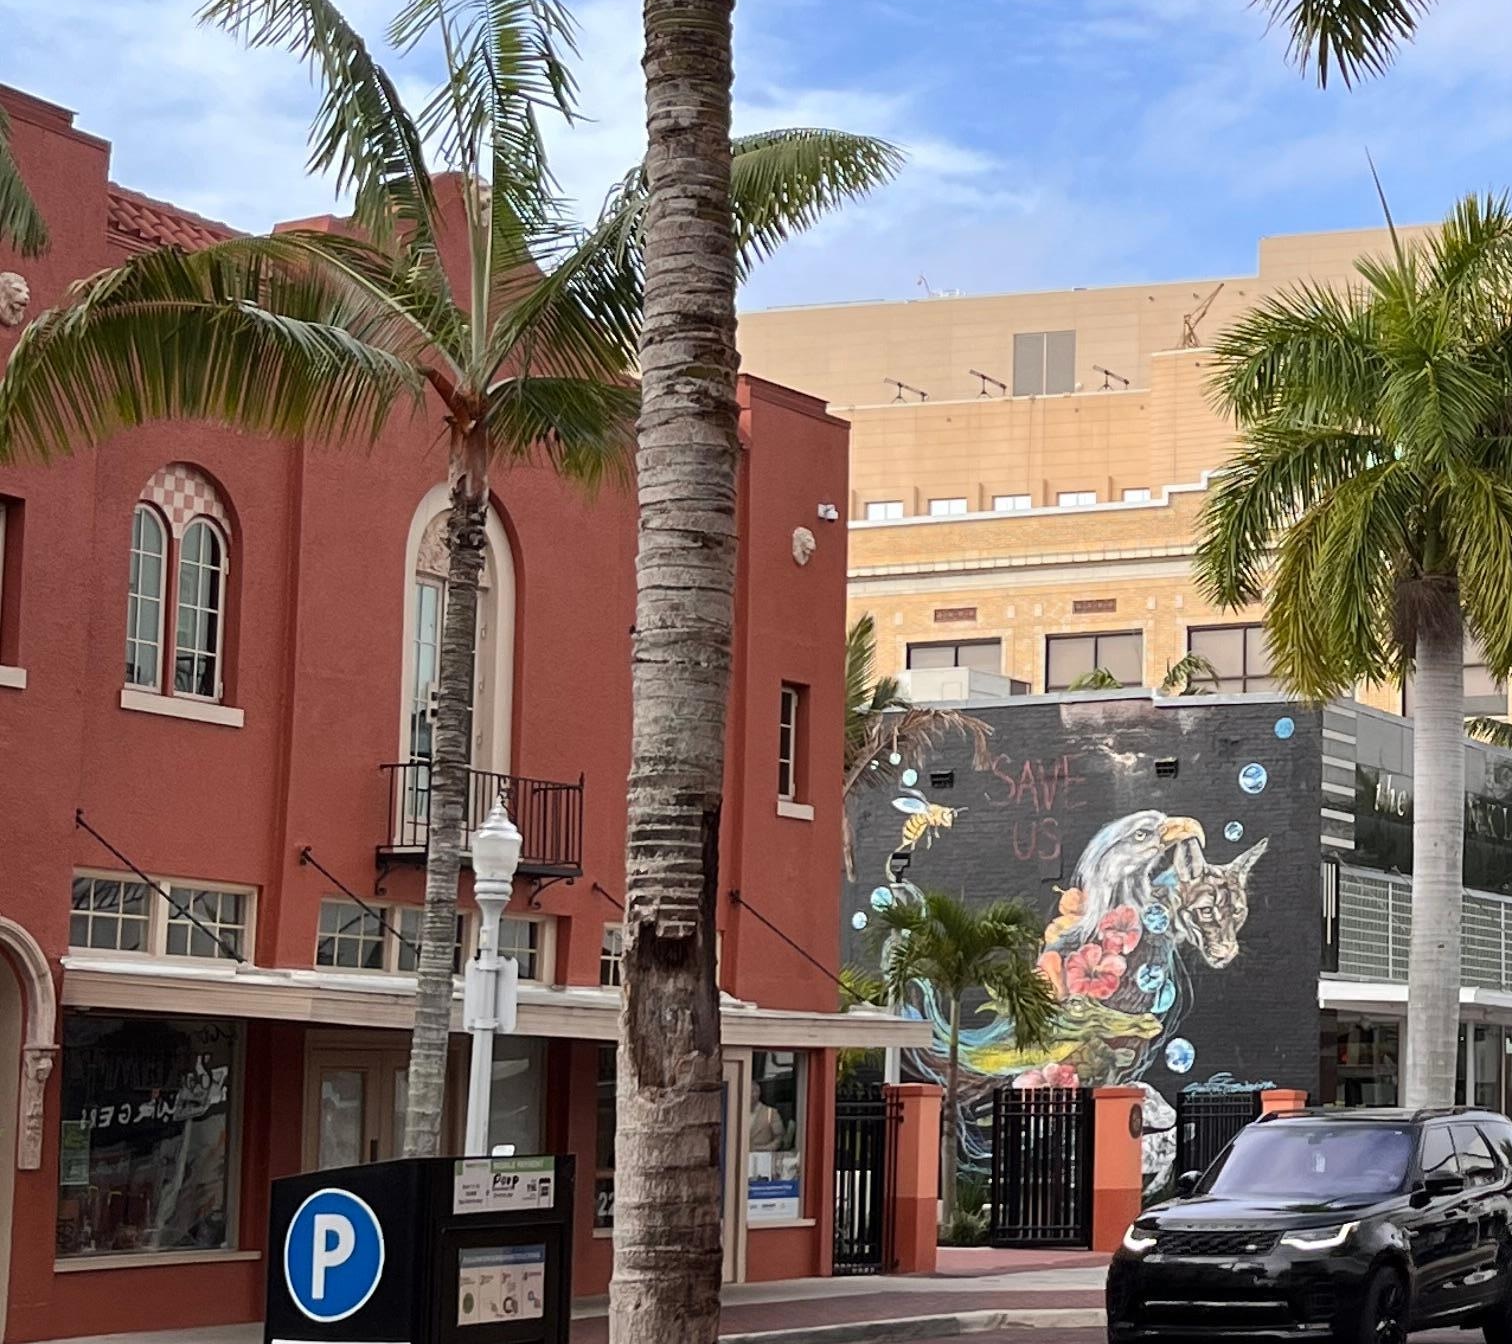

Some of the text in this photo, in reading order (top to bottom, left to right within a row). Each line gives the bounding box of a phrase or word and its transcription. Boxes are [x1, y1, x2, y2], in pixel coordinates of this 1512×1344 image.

[984, 751, 1088, 813] SAVE
[1374, 774, 1408, 817] the
[1012, 817, 1061, 860] US
[310, 1213, 356, 1301] P
